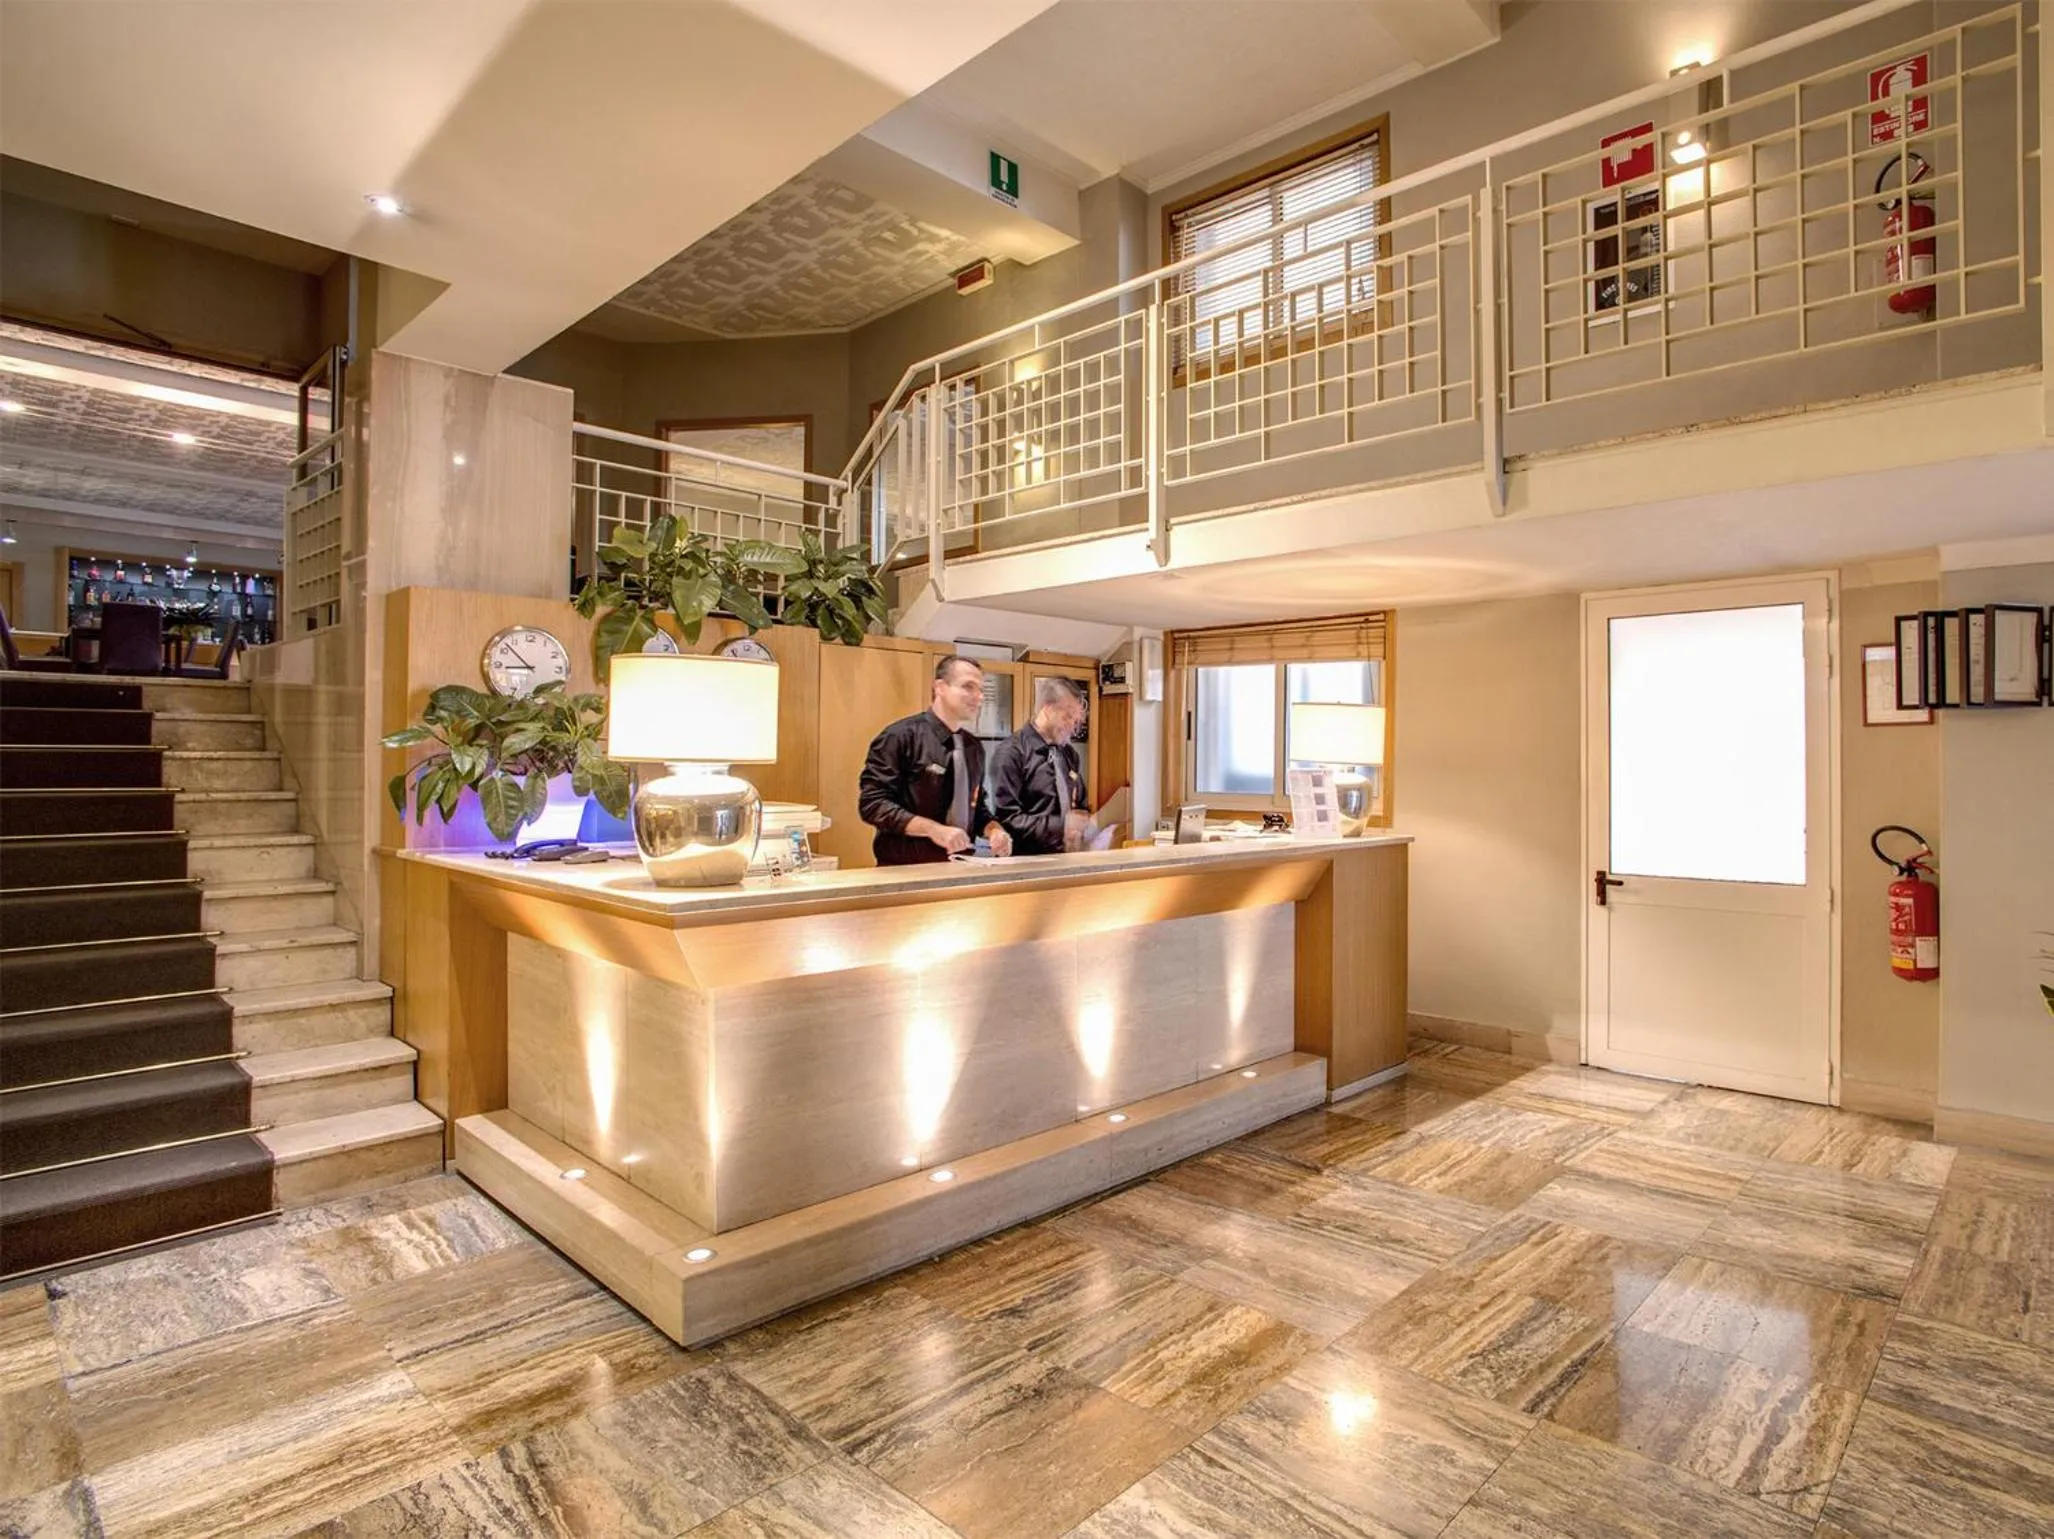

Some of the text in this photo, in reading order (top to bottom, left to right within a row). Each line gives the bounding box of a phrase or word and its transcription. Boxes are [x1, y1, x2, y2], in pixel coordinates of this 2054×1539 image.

[1873, 112, 1927, 135] ESTINORE
[525, 634, 536, 643] 12
[551, 651, 559, 659] 2
[494, 660, 503, 669] 9
[554, 665, 563, 674] 3
